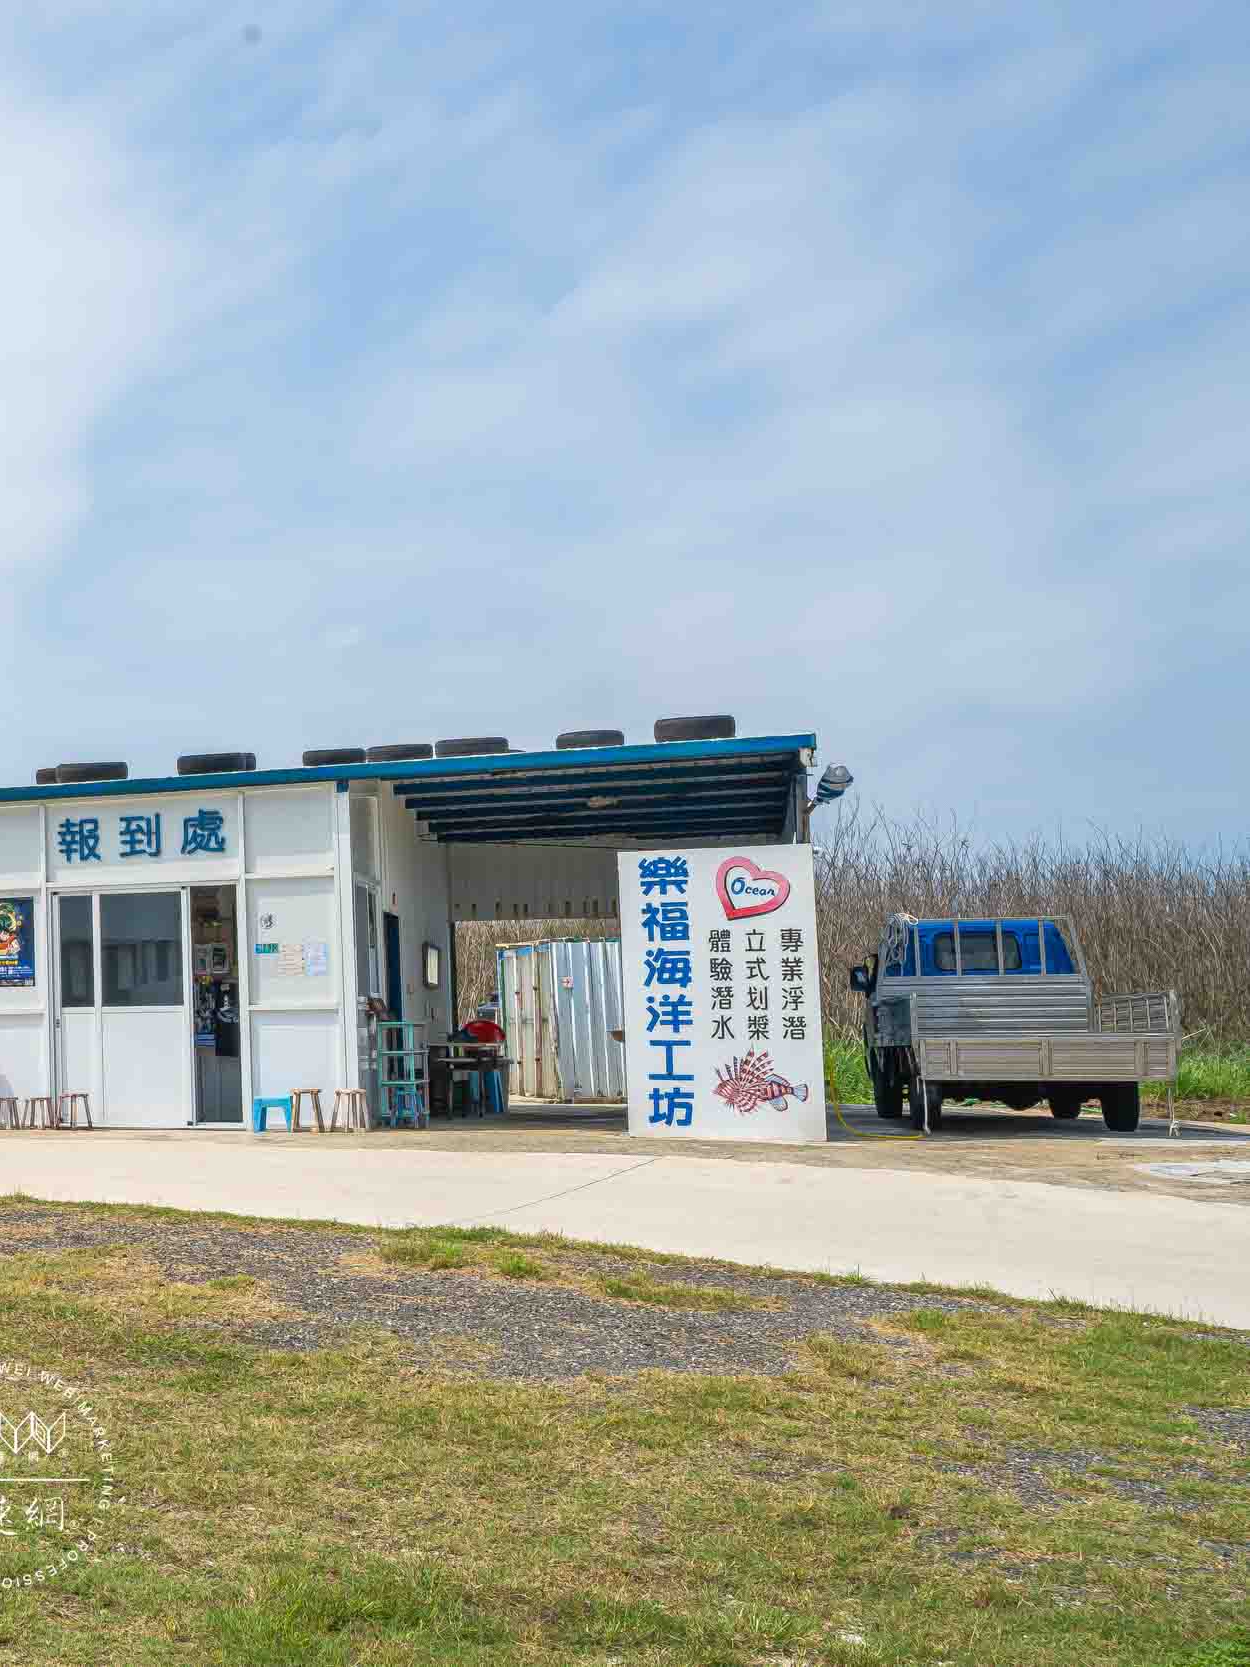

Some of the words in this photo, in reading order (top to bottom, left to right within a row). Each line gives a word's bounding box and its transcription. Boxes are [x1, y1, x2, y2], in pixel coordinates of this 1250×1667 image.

[58, 808, 226, 863] 報到處
[731, 877, 776, 897] Ocean
[638, 856, 694, 1127] 樂福海洋工坊
[709, 929, 735, 1041] 體驗潛水
[745, 929, 770, 1041] 立式划槳
[780, 928, 807, 1041] 專業浮潛
